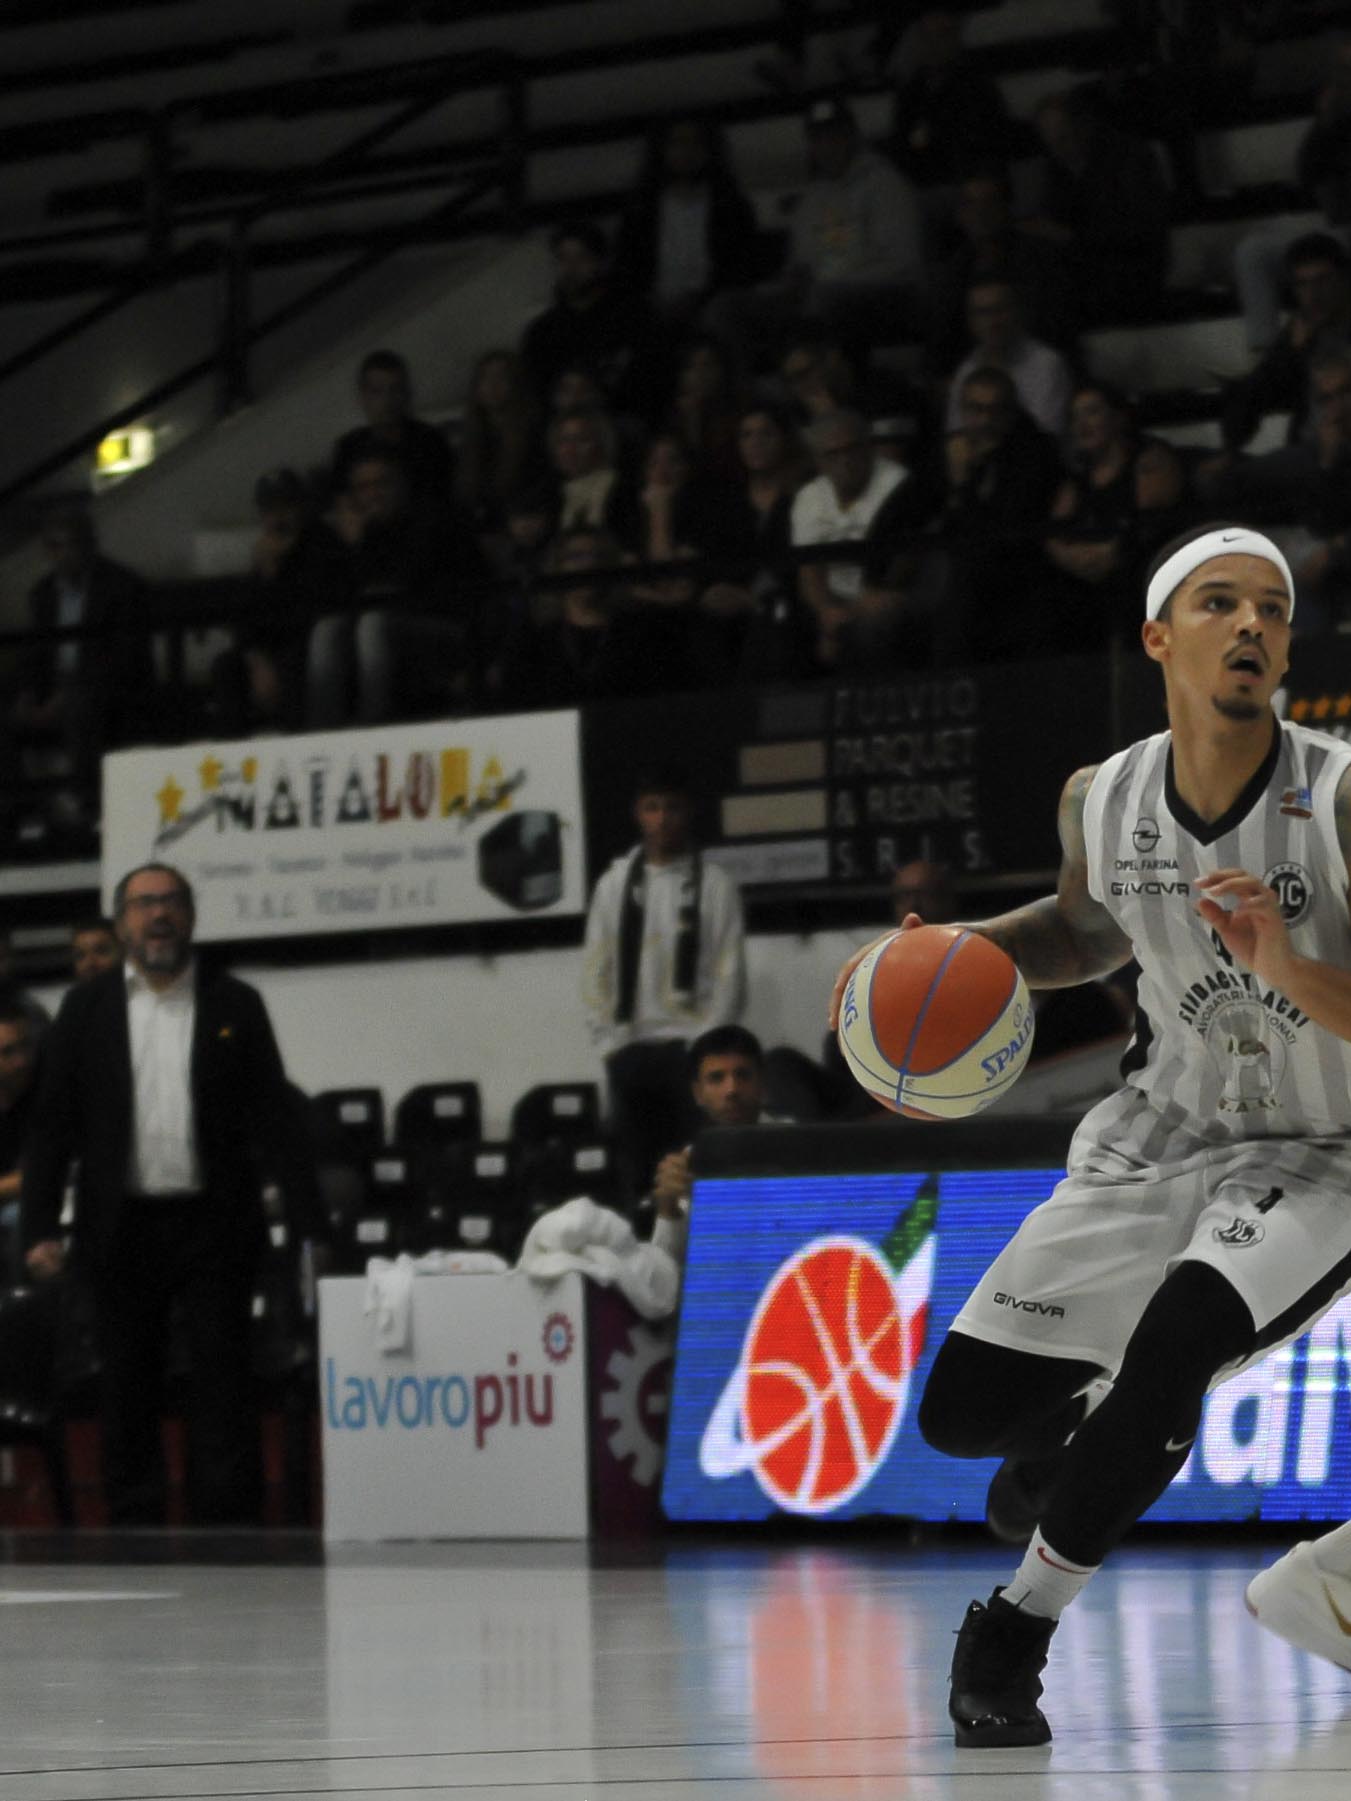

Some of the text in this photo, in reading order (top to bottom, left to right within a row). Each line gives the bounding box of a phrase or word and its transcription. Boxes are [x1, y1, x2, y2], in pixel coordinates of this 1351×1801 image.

[834, 727, 977, 777] PARQUET
[1140, 858, 1180, 872] FARINA
[1110, 881, 1190, 897] GIVOVA
[993, 1291, 1066, 1319] GIVOVA
